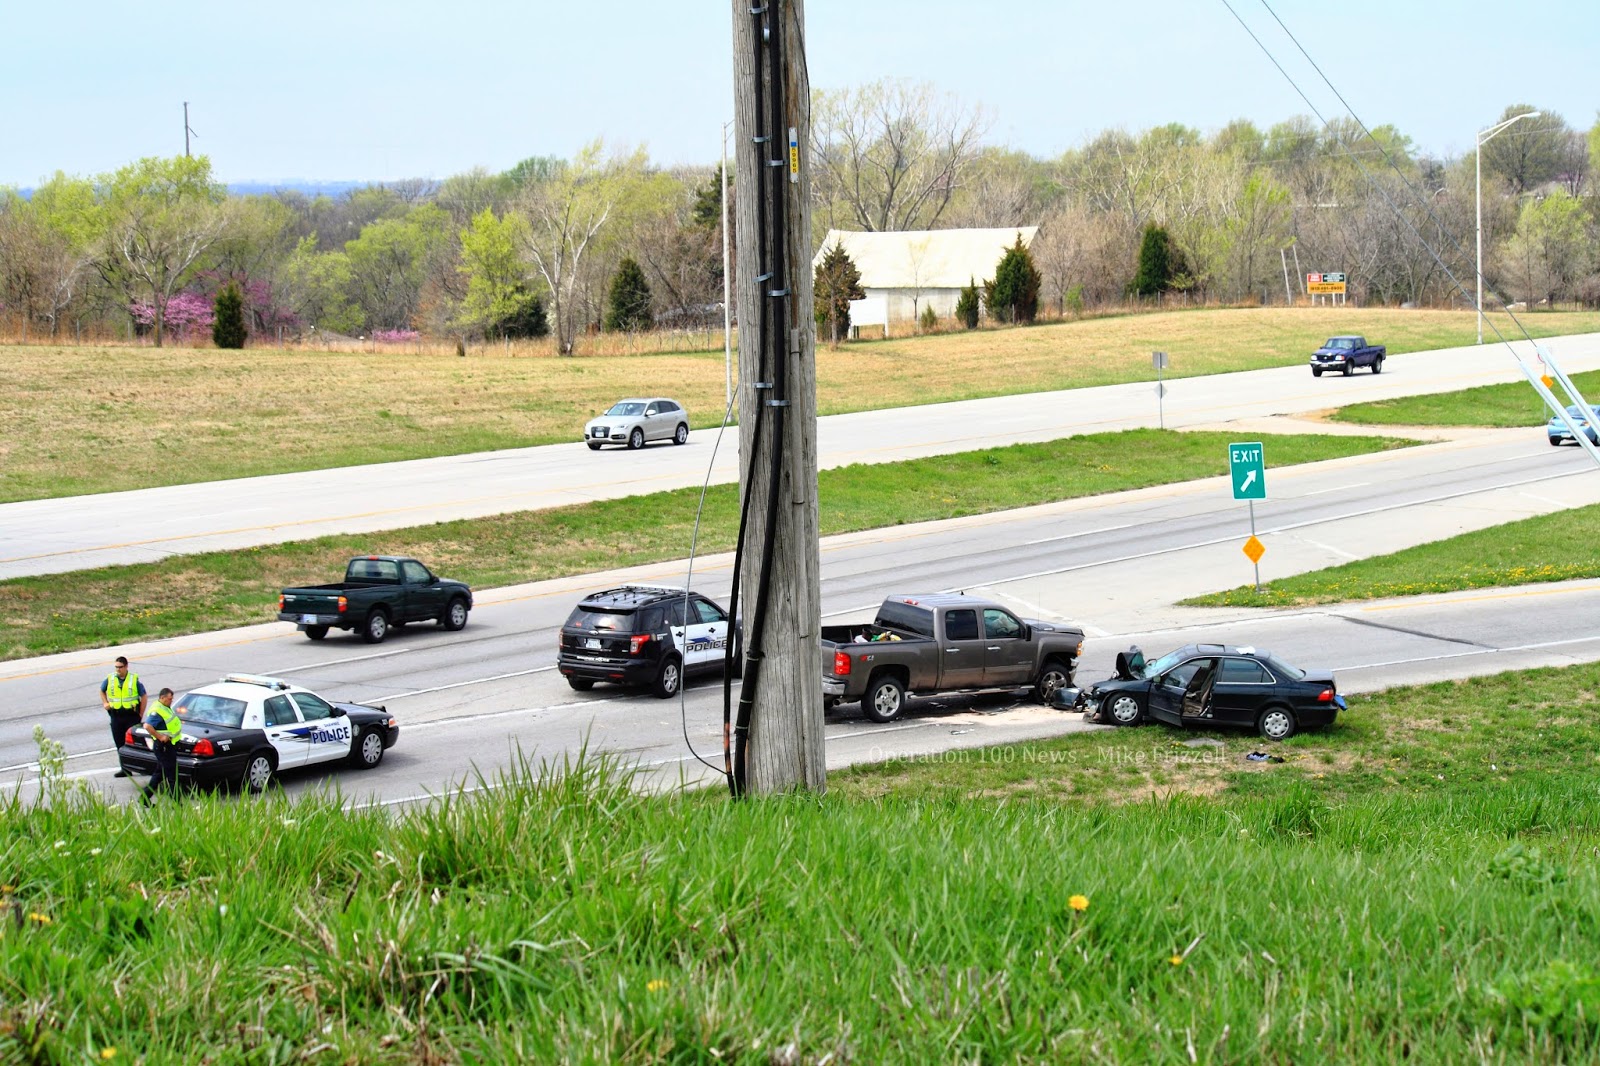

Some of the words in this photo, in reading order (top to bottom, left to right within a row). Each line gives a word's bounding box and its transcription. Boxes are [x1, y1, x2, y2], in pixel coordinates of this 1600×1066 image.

[1232, 449, 1260, 463] EXIT
[685, 640, 728, 653] POLICE
[311, 726, 351, 744] POLICE
